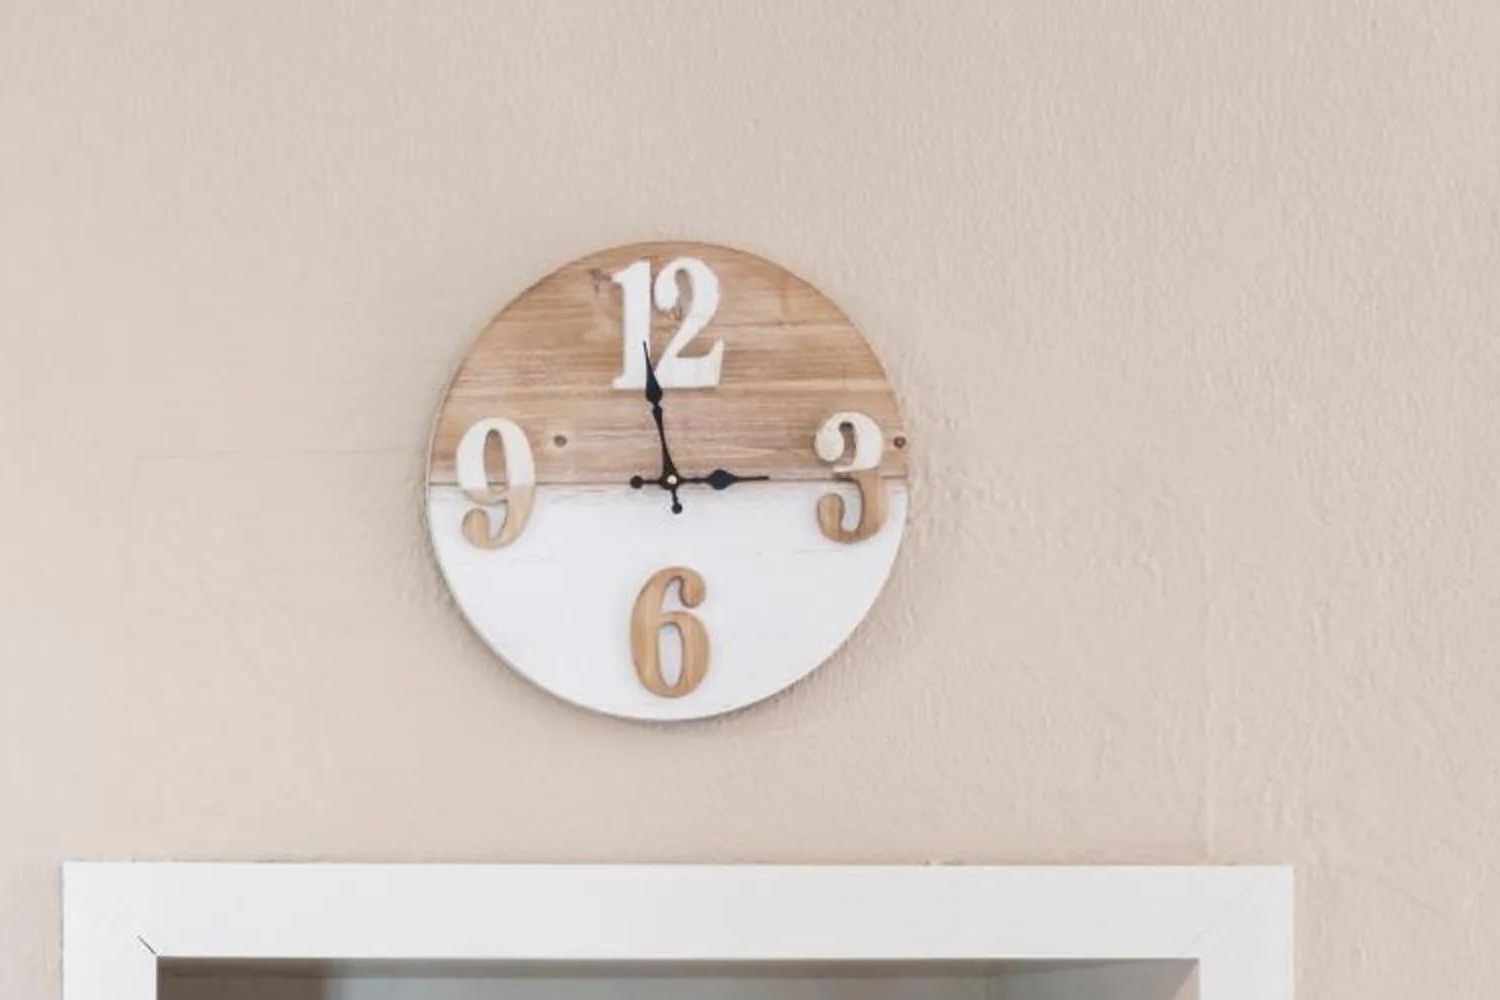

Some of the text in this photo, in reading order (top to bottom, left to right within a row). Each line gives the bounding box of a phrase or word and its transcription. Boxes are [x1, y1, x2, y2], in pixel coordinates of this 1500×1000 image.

[610, 257, 725, 390] 12
[456, 418, 535, 549] 9
[813, 412, 888, 544] 3
[630, 566, 711, 699] 6
